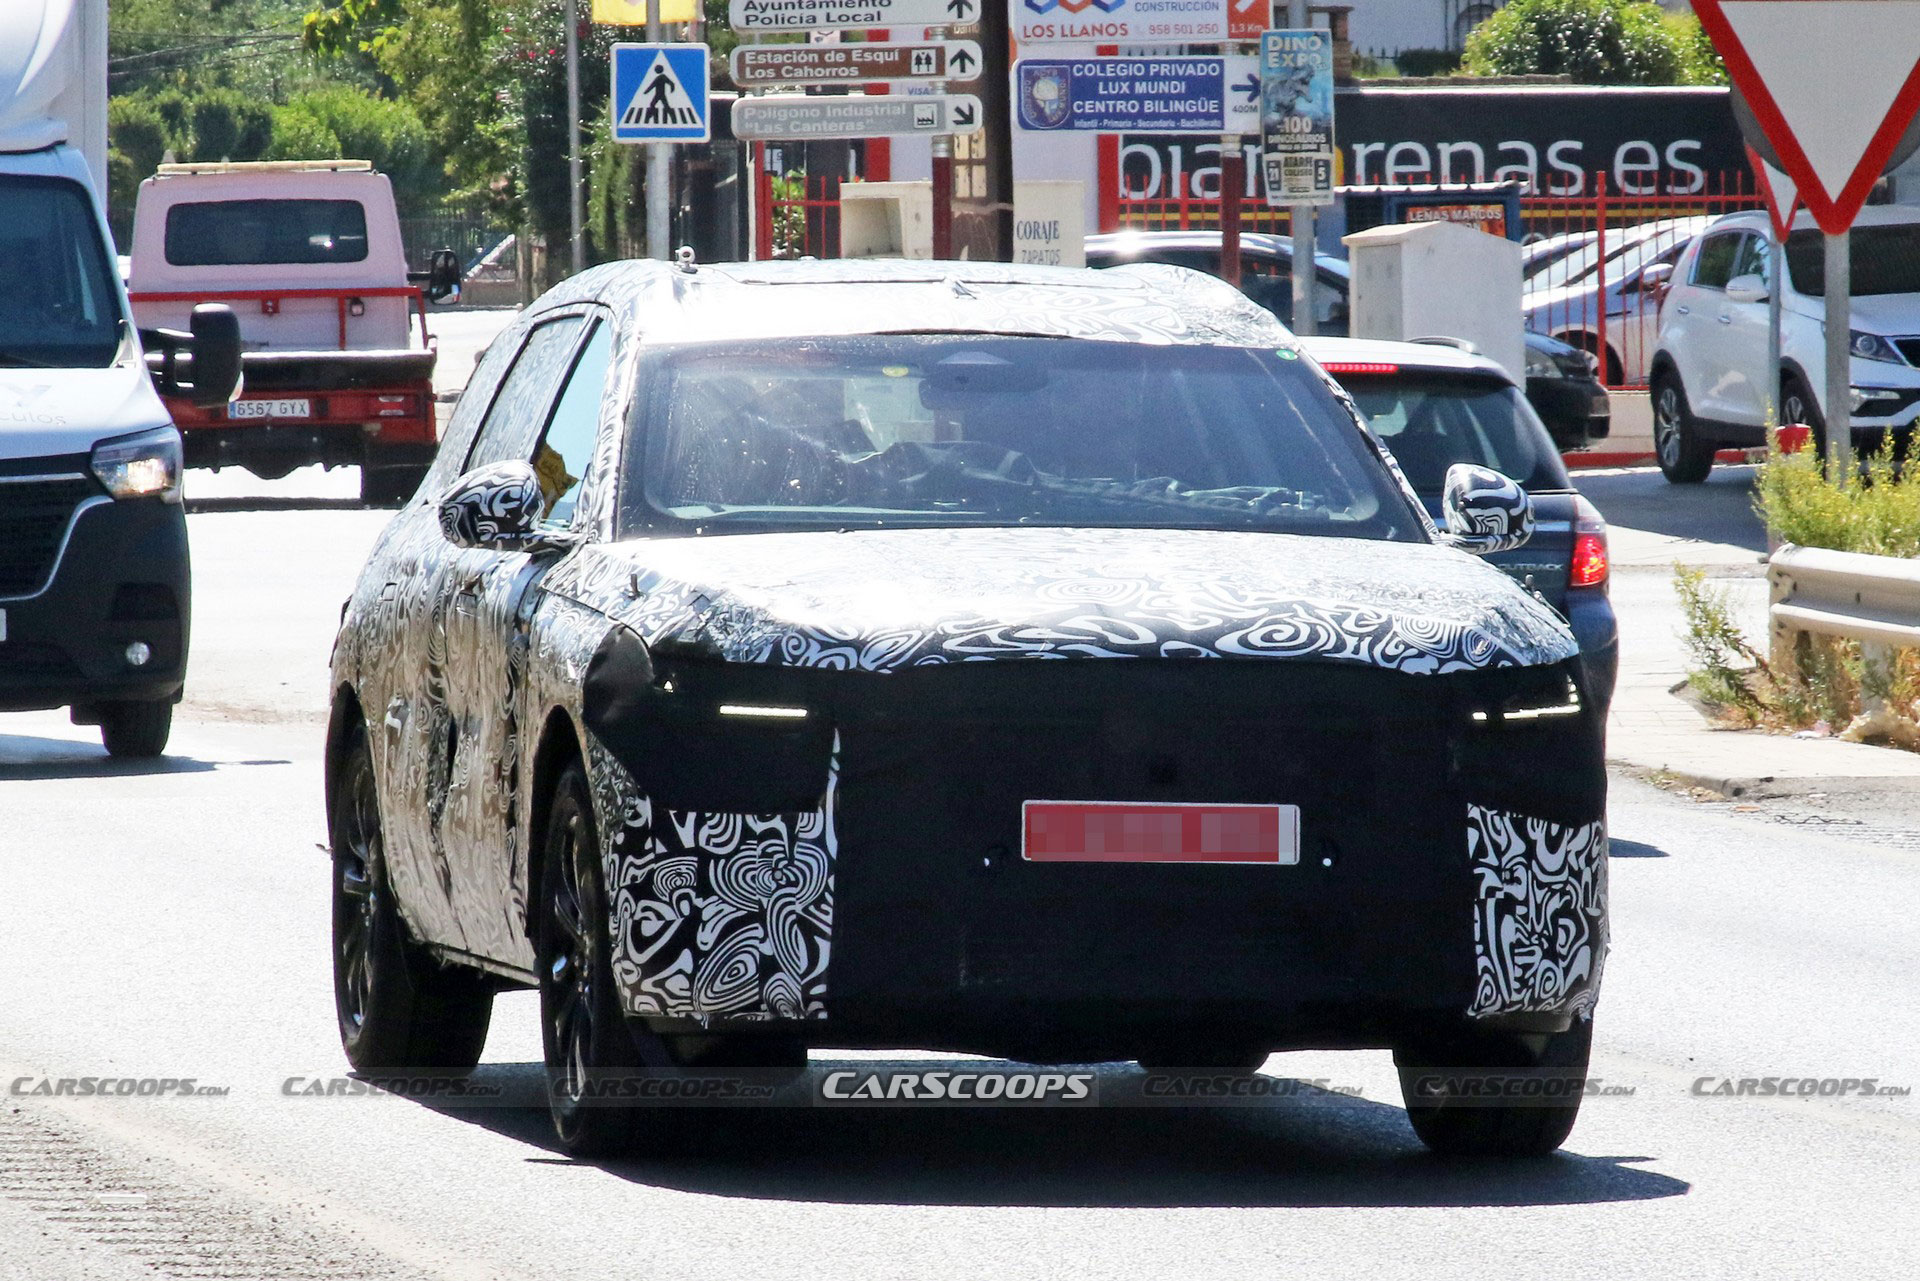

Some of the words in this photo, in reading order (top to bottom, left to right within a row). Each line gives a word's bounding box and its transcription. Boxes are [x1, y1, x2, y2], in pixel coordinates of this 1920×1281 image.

[744, 0, 891, 13] Ayuntamiento
[826, 11, 881, 23] Local
[1023, 25, 1055, 38] LOS
[1060, 23, 1128, 38] LLANOS
[1267, 36, 1322, 51] DINO
[745, 50, 818, 64] Estación
[824, 50, 846, 62] de
[852, 48, 899, 64] Esquí
[1267, 53, 1323, 68] EXPO
[745, 66, 776, 79] Los
[781, 65, 859, 78] Cahorros
[1072, 63, 1145, 76] COLEGIO
[1149, 63, 1220, 76] PRIVADO
[908, 87, 930, 95] VISA
[1098, 81, 1130, 94] LUX
[1135, 81, 1186, 94] MUNDI
[826, 103, 907, 117] Industrial
[1072, 100, 1139, 113] CENTRO
[1144, 97, 1219, 113] BILINGÜE
[1452, 208, 1503, 221] MARCOS
[1016, 220, 1060, 244] CORAJE
